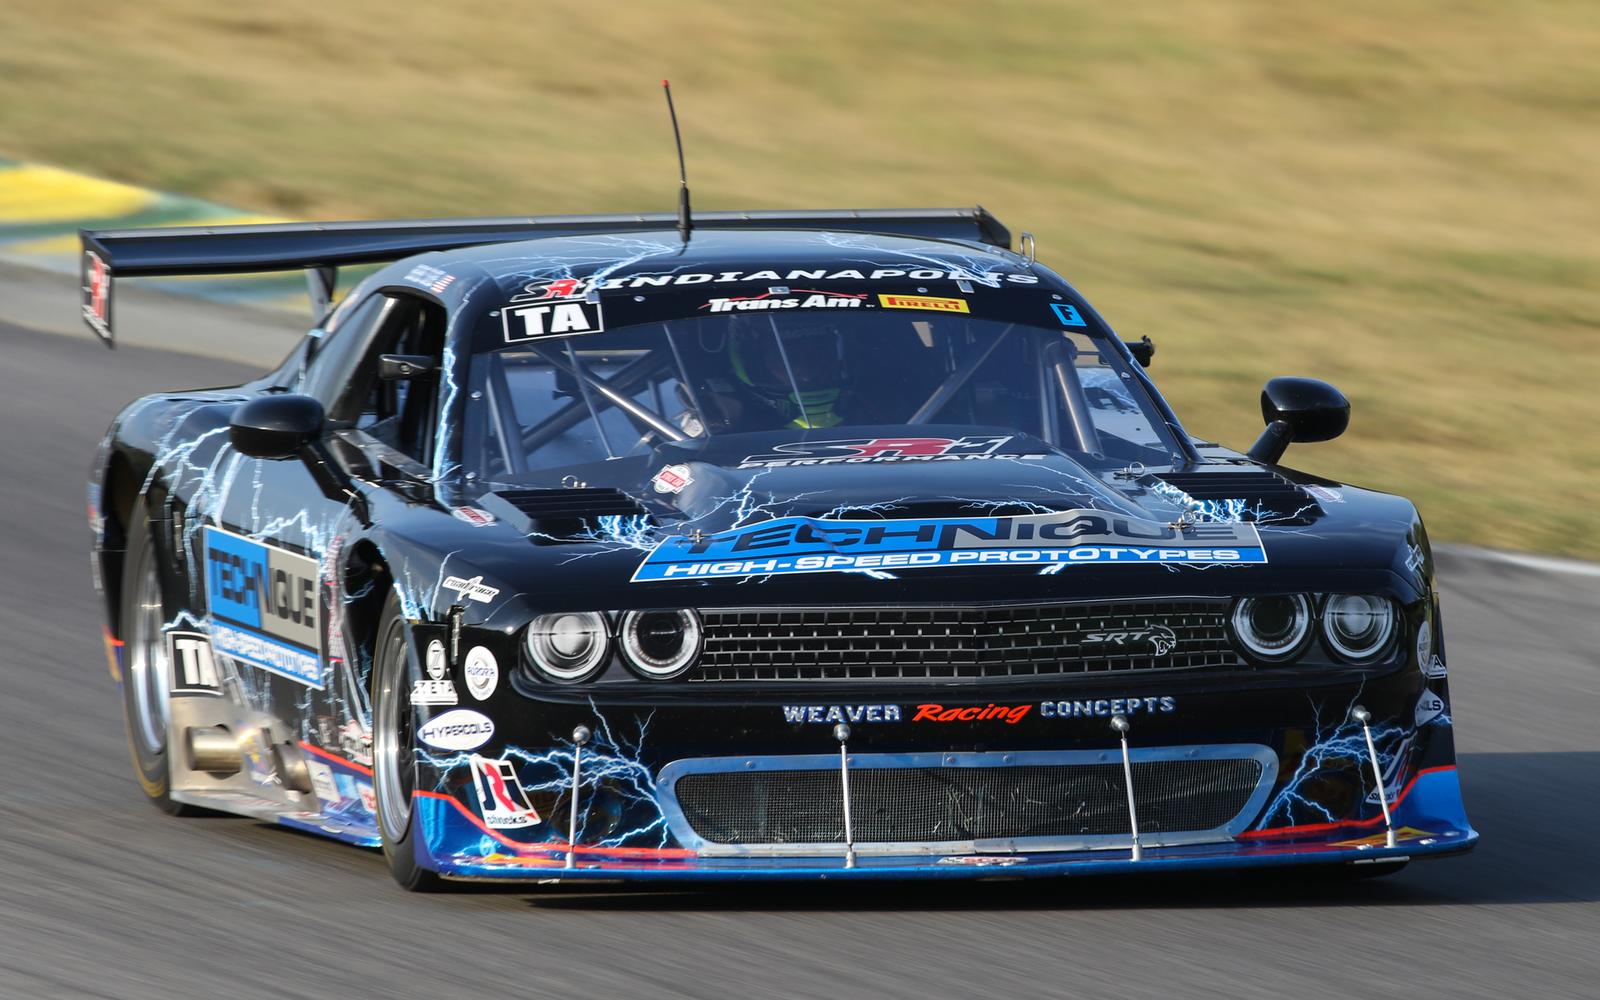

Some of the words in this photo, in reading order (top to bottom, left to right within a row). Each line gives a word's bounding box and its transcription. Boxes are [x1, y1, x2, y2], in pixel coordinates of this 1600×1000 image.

[597, 270, 1038, 290] INDIANAPOLIS
[709, 297, 800, 312] Trans
[800, 295, 861, 308] Am
[886, 296, 961, 311] PIRELLI
[514, 303, 591, 336] TA
[737, 454, 1046, 469] PERFORMANCE
[675, 515, 1239, 554] TECHNIQUE
[663, 553, 941, 576] HIGH-SPEED
[949, 547, 1240, 562] PROTOTYPES
[209, 547, 314, 629] TECHNIQUE
[1080, 631, 1151, 645] SRT
[782, 704, 903, 723] WEAVER
[911, 703, 1033, 724] Racing
[1039, 696, 1176, 718] CONCEPTS
[422, 722, 492, 739] HYPERCOILS
